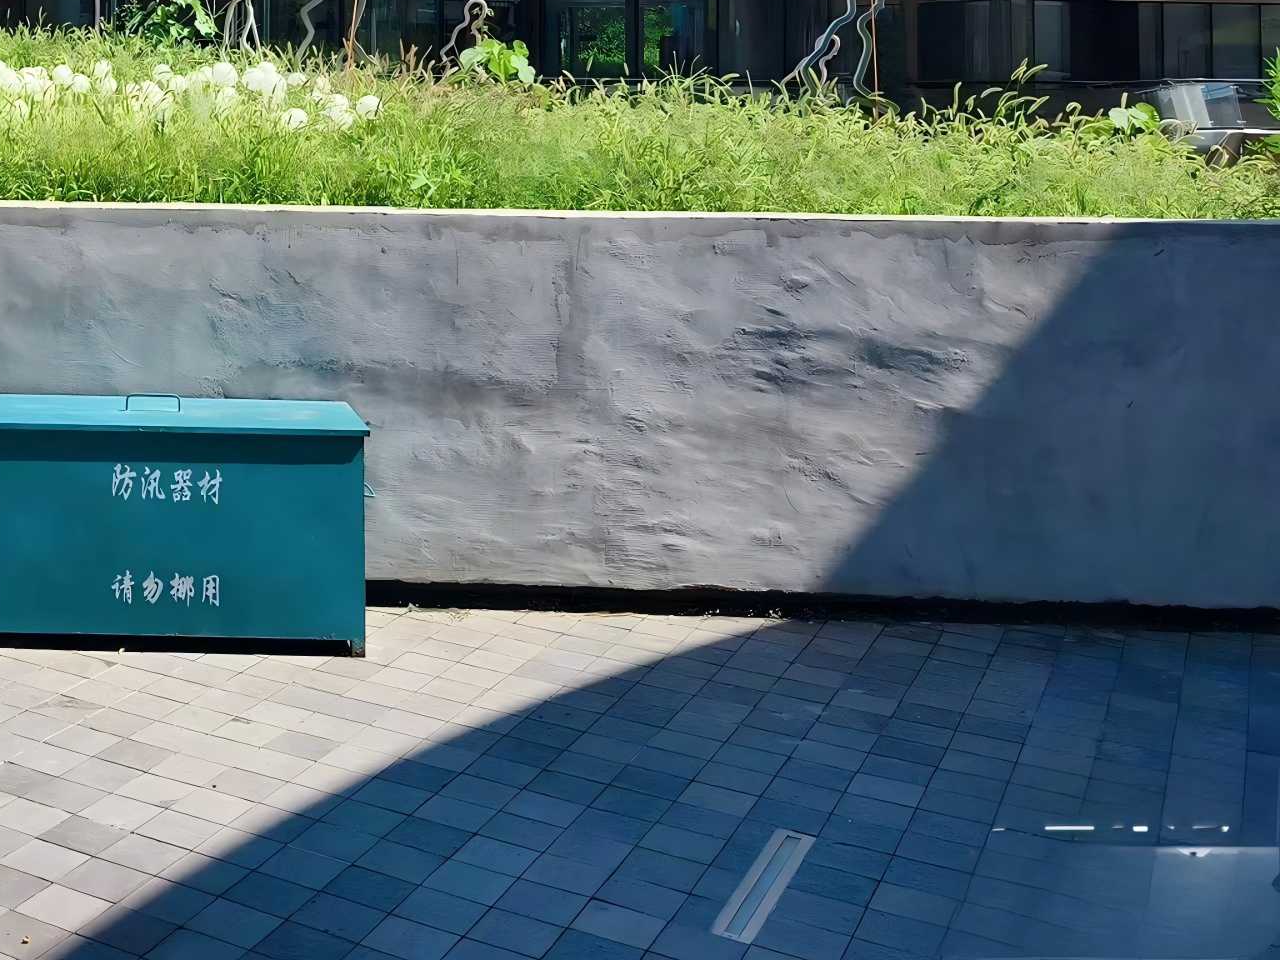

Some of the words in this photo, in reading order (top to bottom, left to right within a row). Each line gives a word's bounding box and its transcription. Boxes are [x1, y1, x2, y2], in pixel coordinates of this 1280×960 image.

[112, 463, 222, 505] 防汛器材
[111, 569, 220, 608] 请勿挪用
